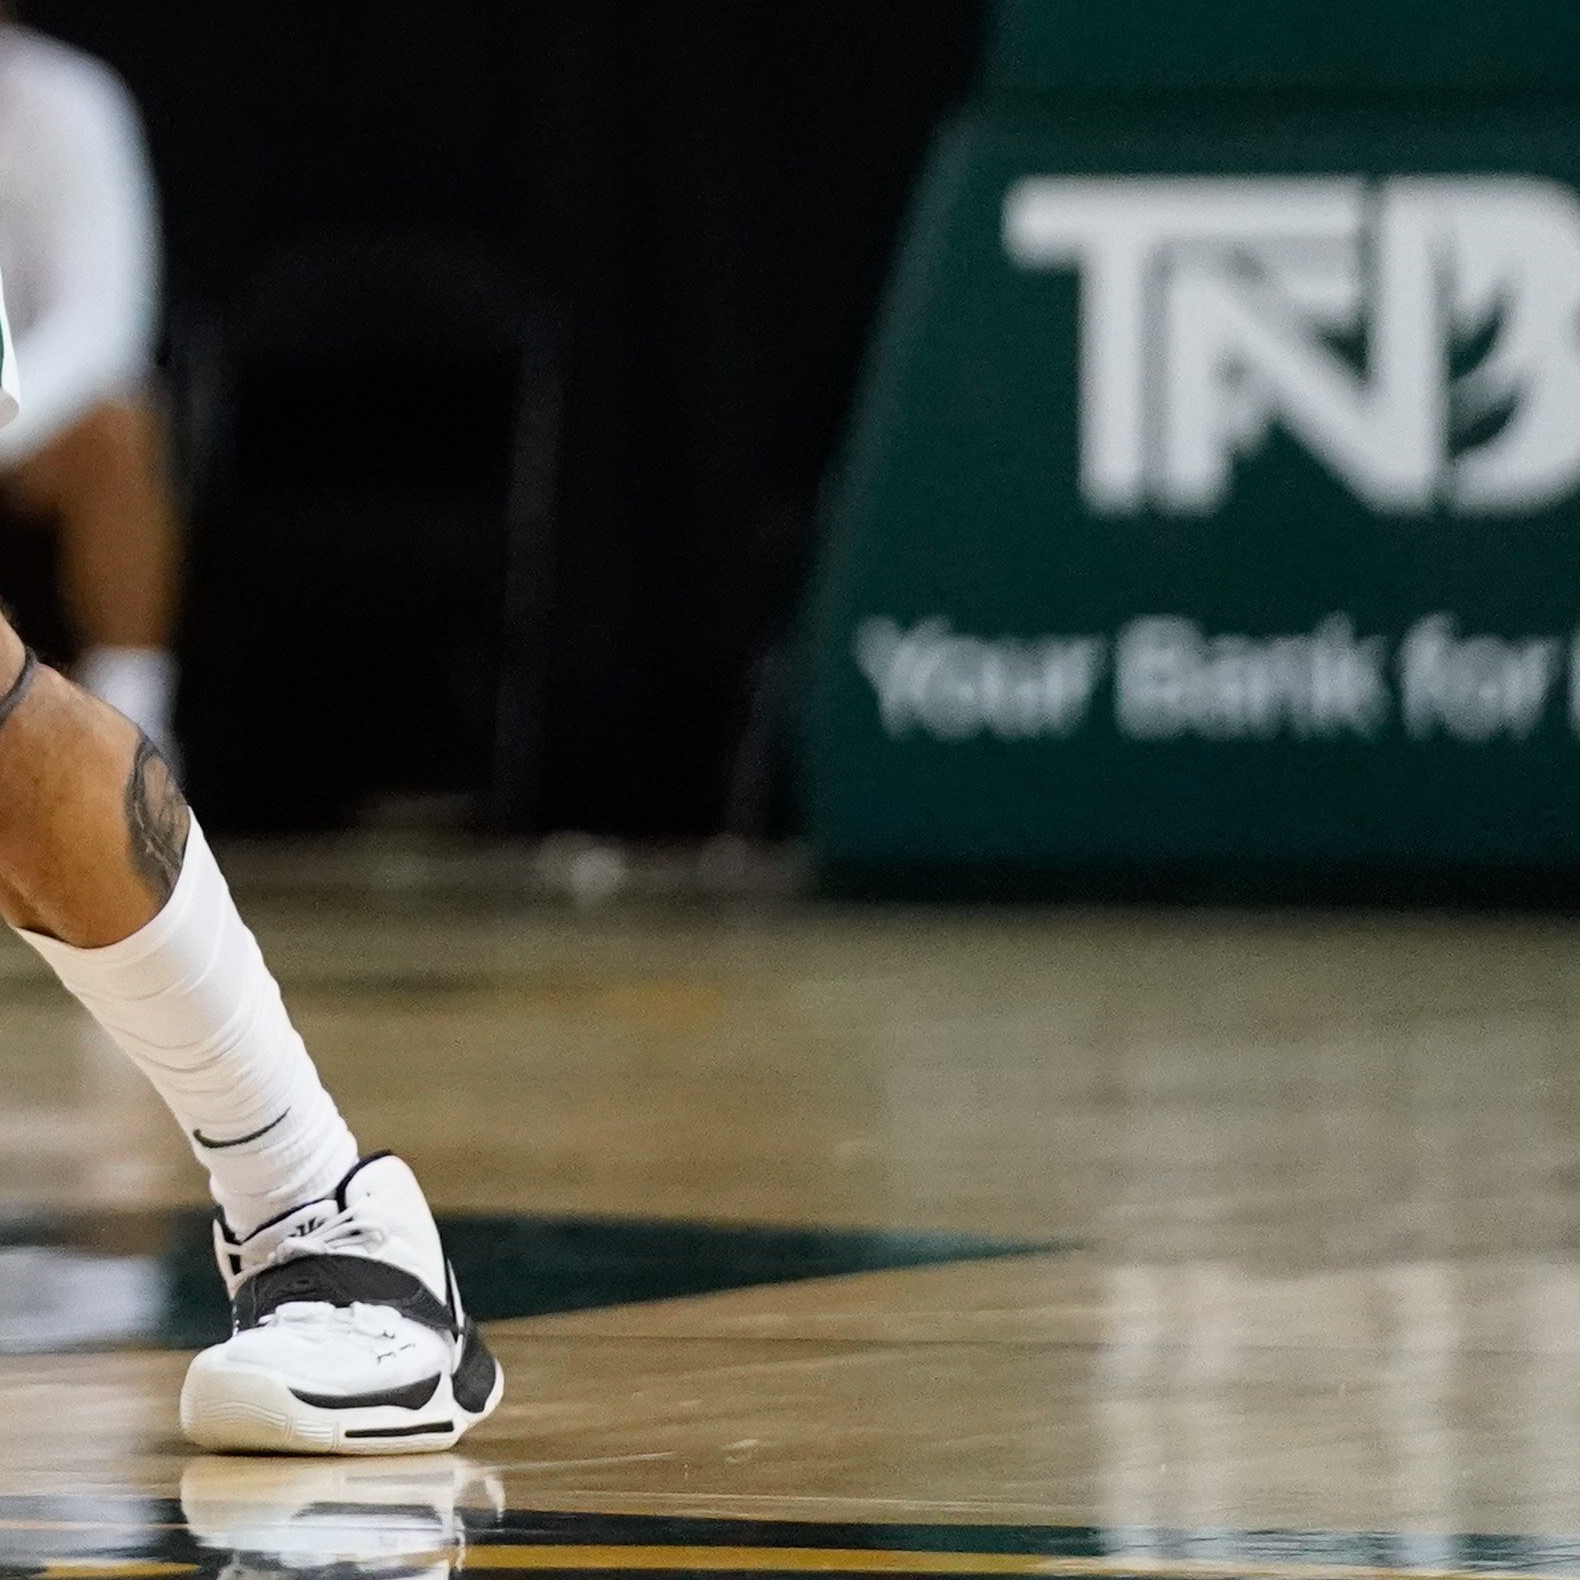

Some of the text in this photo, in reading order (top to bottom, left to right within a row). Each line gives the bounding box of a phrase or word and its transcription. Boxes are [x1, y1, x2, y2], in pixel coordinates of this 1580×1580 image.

[855, 616, 1102, 740] Your
[1115, 616, 1388, 740] Bank
[1399, 614, 1564, 740] for
